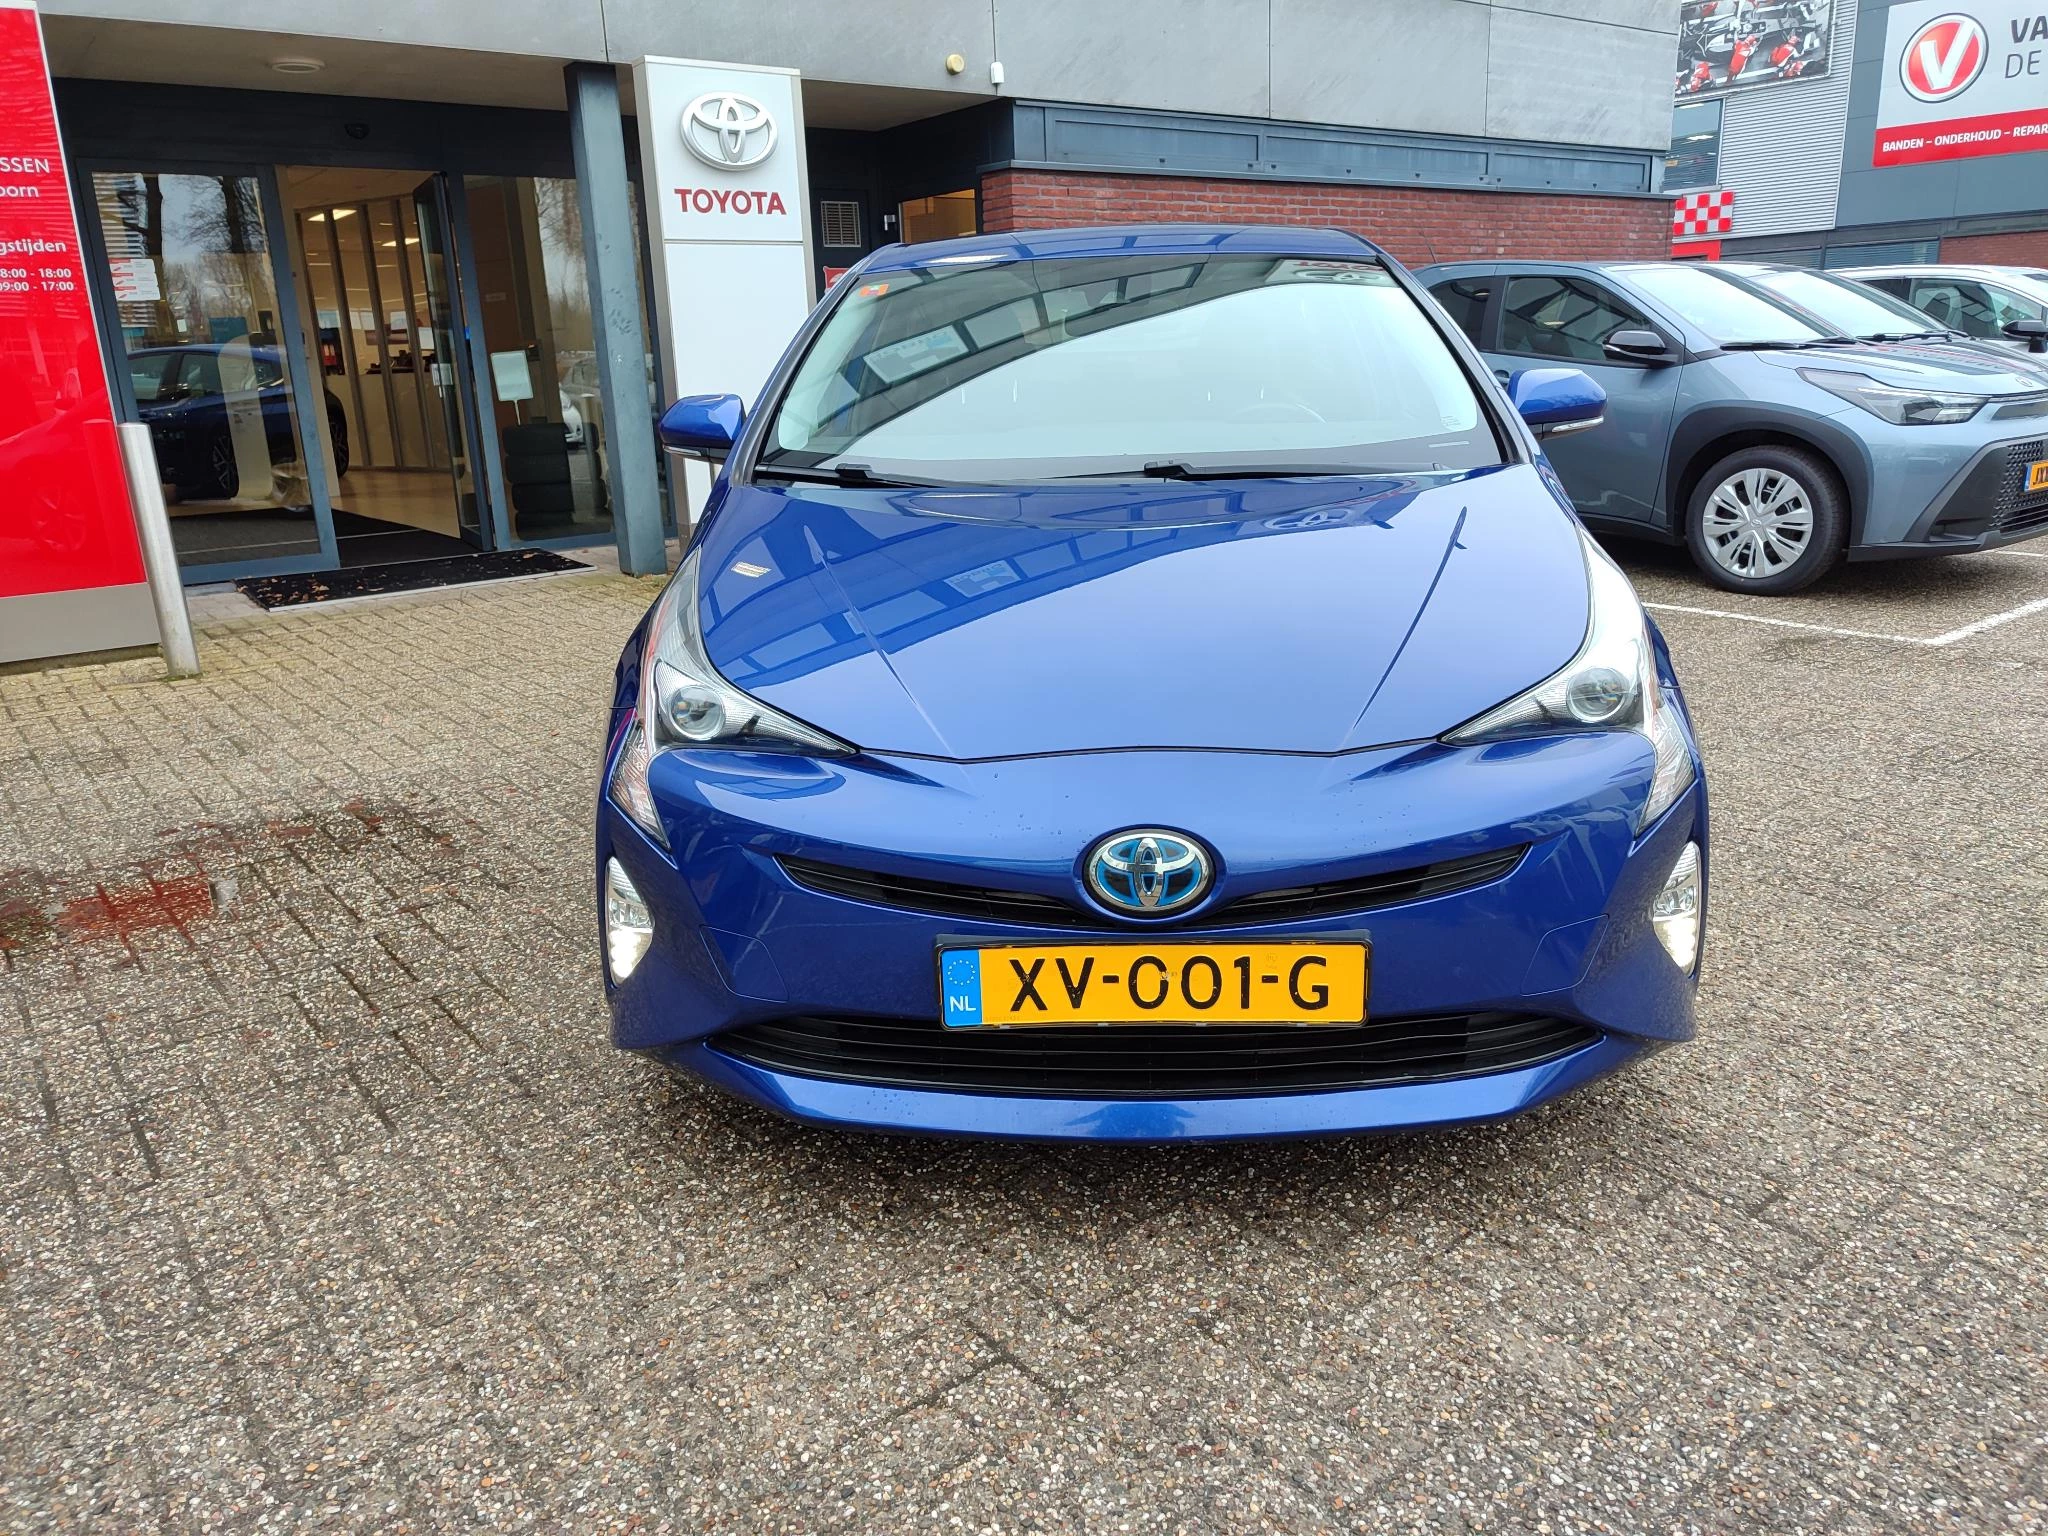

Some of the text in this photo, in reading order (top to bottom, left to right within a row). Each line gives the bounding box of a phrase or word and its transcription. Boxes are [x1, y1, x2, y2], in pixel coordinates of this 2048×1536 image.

[2011, 15, 2048, 44] VA
[2004, 50, 2042, 79] DE
[1882, 138, 1924, 152] BANDEN
[1934, 129, 2002, 146] ONDERHOUD
[0, 156, 50, 174] SSEN
[674, 188, 787, 215] TOYOTA
[38, 268, 72, 279] 18:00
[41, 281, 74, 292] 17:00
[1009, 955, 1329, 1012] XV-001-G
[949, 995, 977, 1012] NL
